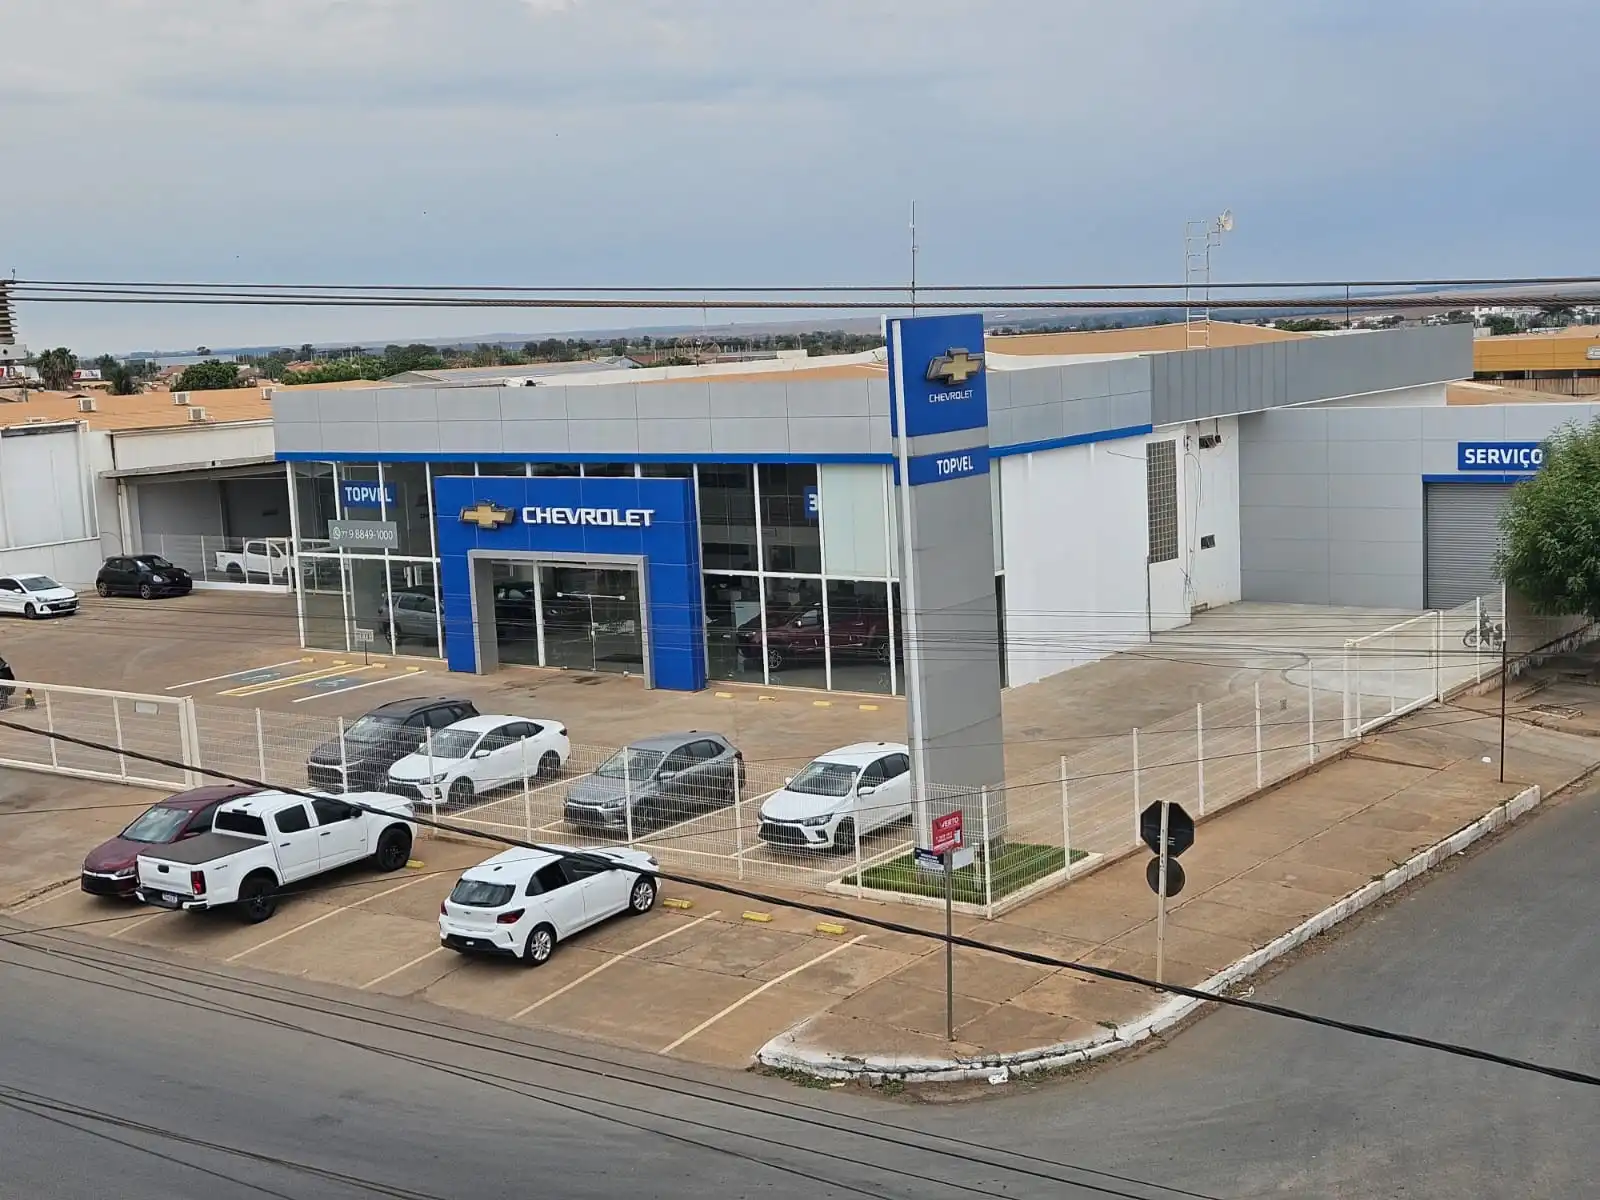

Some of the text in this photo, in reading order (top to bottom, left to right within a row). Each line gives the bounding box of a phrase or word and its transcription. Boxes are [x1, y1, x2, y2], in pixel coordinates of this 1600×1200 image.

[928, 389, 974, 403] CHEVROLET
[936, 455, 974, 475] TOPVEL
[521, 506, 655, 527] CHEVROLET
